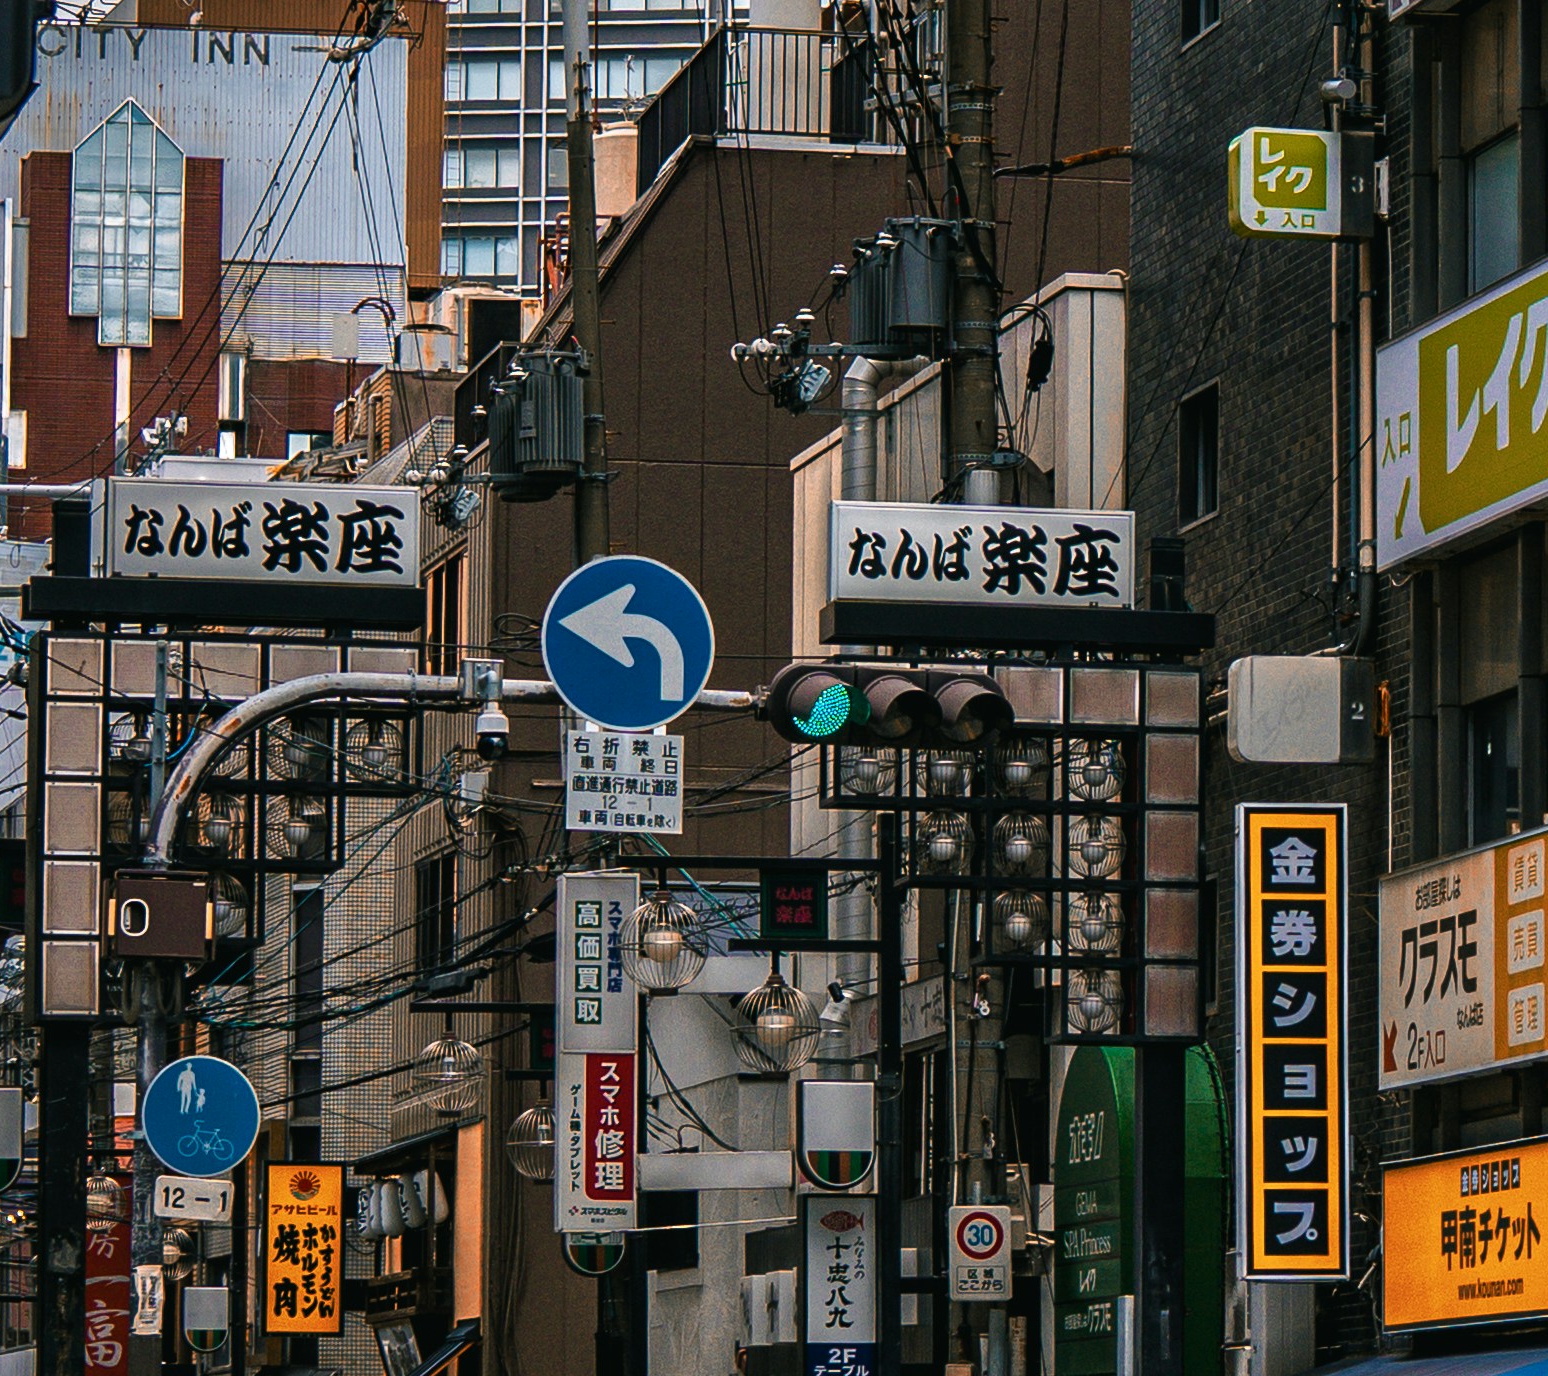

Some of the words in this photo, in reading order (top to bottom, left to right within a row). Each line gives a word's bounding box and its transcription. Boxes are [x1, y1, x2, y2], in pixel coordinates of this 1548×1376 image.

[192, 29, 271, 67] INN
[1281, 211, 1317, 230] 入口
[1380, 410, 1413, 464] 入口
[847, 523, 1122, 599] なんば楽座
[572, 735, 679, 759] 右折禁止
[572, 774, 678, 798] 直進通行禁止道路
[1414, 873, 1462, 911] お部屋探しは
[1512, 851, 1540, 893] 賃貸
[775, 886, 814, 902] なんば
[1398, 908, 1479, 1010] クラスモ
[1512, 922, 1539, 962] 売買
[576, 902, 601, 1023] 高価買取
[1264, 831, 1329, 1250] 金券ショップ
[594, 1061, 625, 1191] スマホ修理
[1461, 1157, 1522, 1197] 金券ショップ
[271, 1204, 338, 1217] アサヒビール
[967, 1224, 993, 1247] 30
[1439, 1201, 1542, 1272] 甲南チケット
[272, 1223, 301, 1319] 焼肉
[302, 1222, 319, 1319] ホルモン
[319, 1224, 337, 1319] かすうどん
[958, 1279, 1004, 1292] ここから
[1457, 1275, 1525, 1300] www.kounan.com
[828, 1348, 857, 1364] 2F
